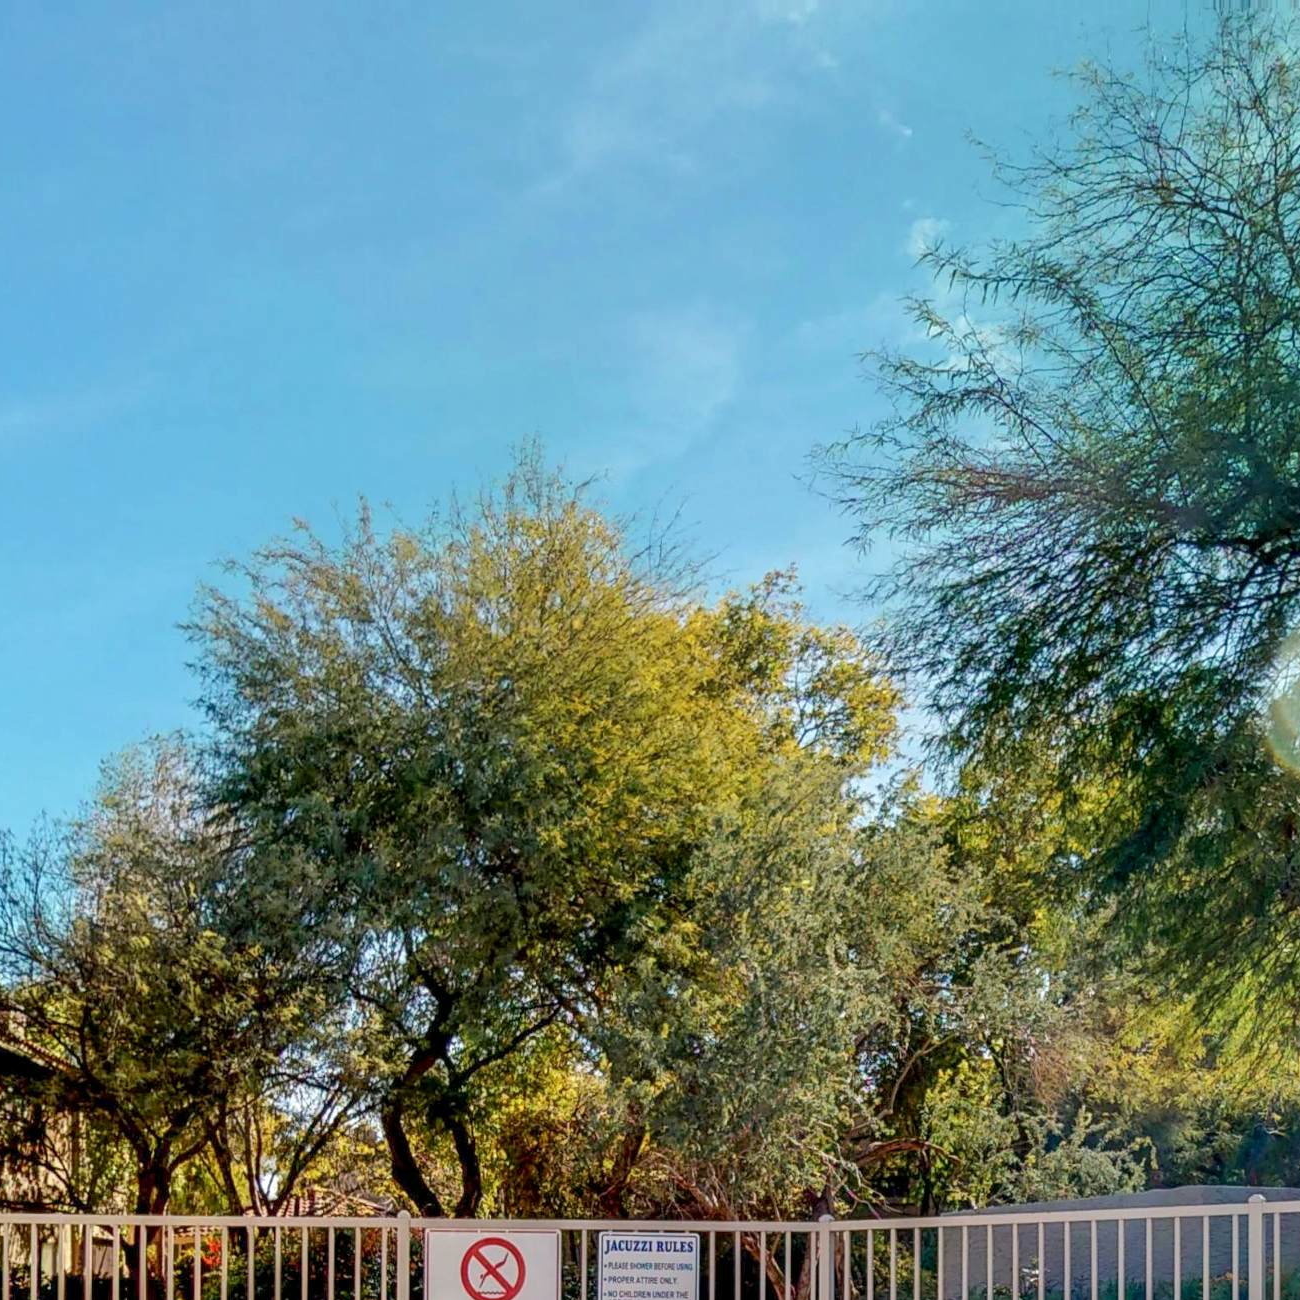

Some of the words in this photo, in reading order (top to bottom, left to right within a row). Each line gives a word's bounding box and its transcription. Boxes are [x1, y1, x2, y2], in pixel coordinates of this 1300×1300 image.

[604, 1239, 652, 1254] JACUZZI
[656, 1241, 693, 1253] RULES
[608, 1262, 629, 1270] PLEASE
[630, 1262, 653, 1270] SHOWER
[654, 1262, 675, 1270] BEFORE
[608, 1276, 635, 1284] PROPER
[636, 1276, 658, 1284] ATTIRE
[608, 1290, 618, 1298] NO
[619, 1290, 652, 1298] CHILDREN
[676, 1291, 689, 1299] THE
